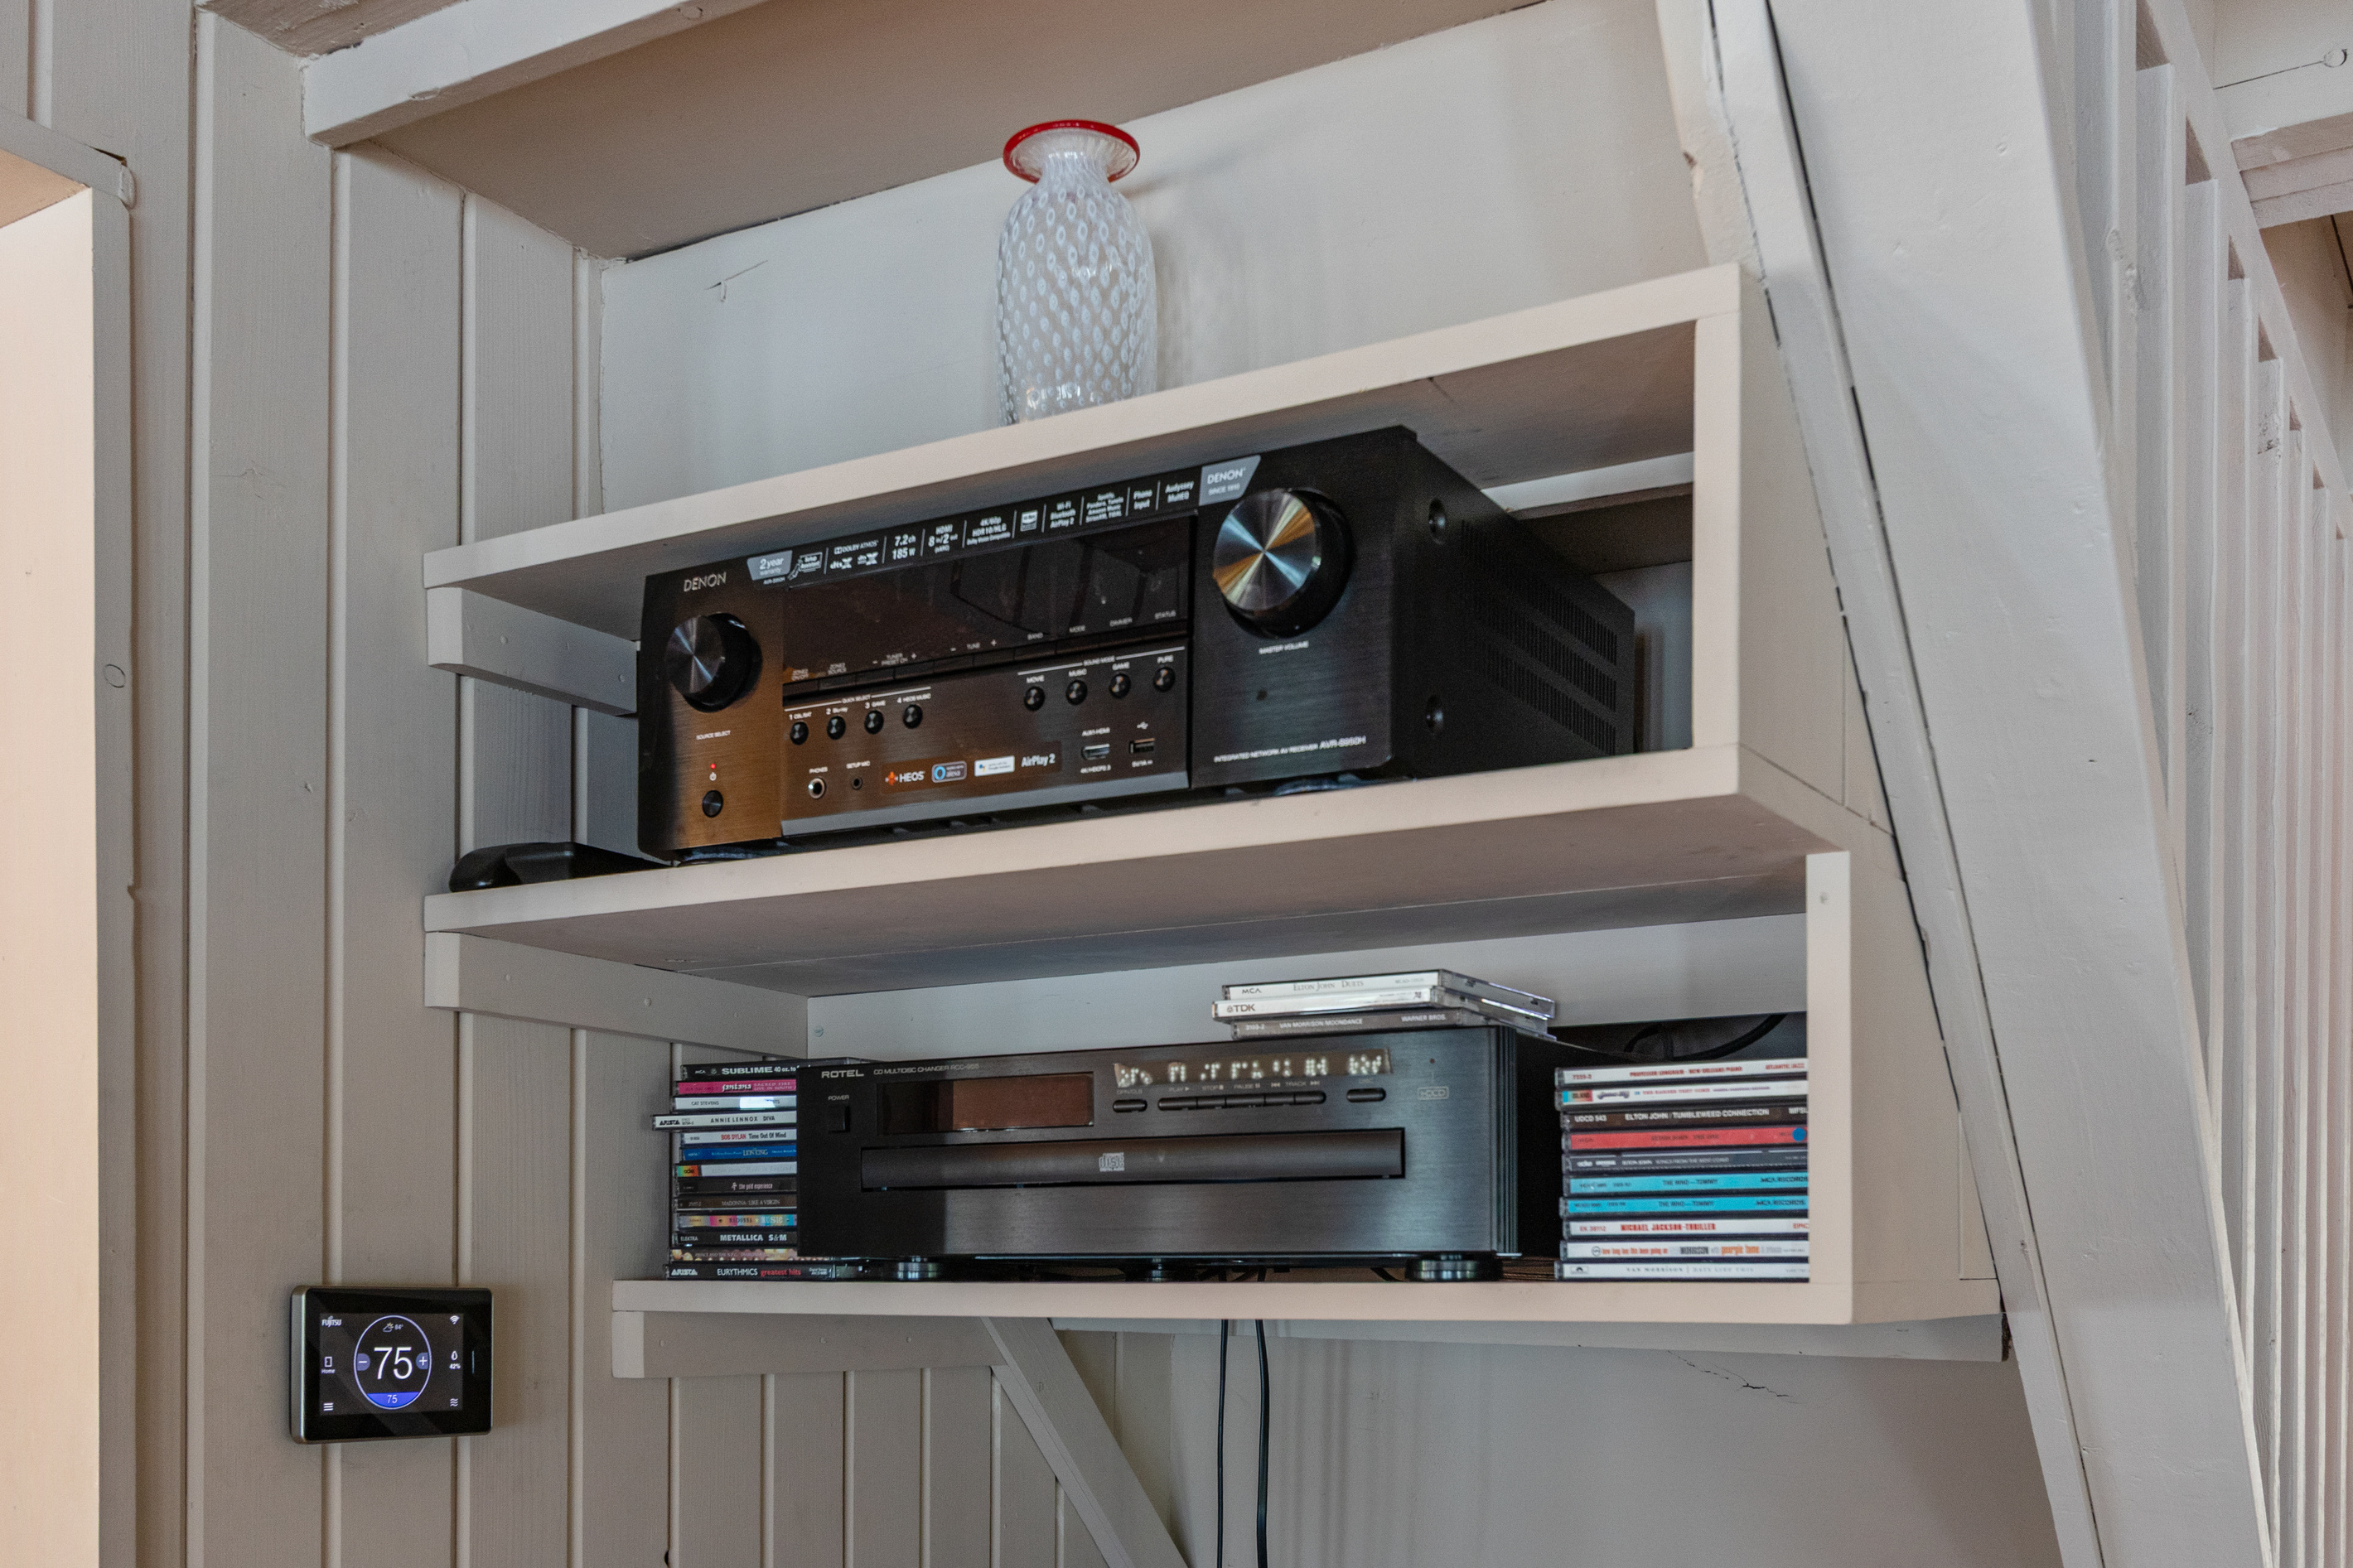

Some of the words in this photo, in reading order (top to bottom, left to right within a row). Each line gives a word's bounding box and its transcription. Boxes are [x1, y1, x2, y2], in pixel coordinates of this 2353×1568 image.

[1207, 469, 1244, 485] DENON
[1133, 490, 1152, 499] Phono
[1208, 486, 1226, 496] SINCE
[1133, 499, 1150, 510] Input
[935, 524, 953, 535] HDMI
[759, 558, 766, 570] 2
[766, 557, 784, 570] year
[684, 572, 727, 592] DENON
[1259, 644, 1284, 654] MASTER
[1284, 640, 1309, 651] VOLUME
[1112, 662, 1130, 670] GAME
[1069, 668, 1087, 677] MUSIC
[1027, 675, 1045, 683] MOVIE
[715, 730, 731, 738] SELECT
[1021, 755, 1048, 767] AirPlay
[1049, 753, 1056, 764] 2
[899, 771, 924, 784] HEOS
[1293, 983, 1315, 991] ELTON
[1316, 982, 1335, 993] JOHN
[1234, 1003, 1256, 1013] TDK
[1401, 1014, 1428, 1022] WARNER
[1292, 1020, 1324, 1029] MORRISON
[1325, 1018, 1363, 1026] MOONDANCE
[722, 1066, 773, 1075] SUBLIME
[821, 1069, 865, 1078] ROTEL
[917, 1065, 949, 1073] CHANGER
[1649, 1112, 1669, 1120] JOHN
[1722, 1108, 1770, 1117] CONNECTION
[1621, 1223, 1649, 1232] MICHAEL
[1651, 1223, 1682, 1231] JACKSON
[768, 1233, 787, 1242] S&M
[671, 1268, 698, 1276] ARISTA
[717, 1267, 758, 1276] EURYTHMICS
[761, 1269, 787, 1277] greatest
[788, 1268, 801, 1276] hits
[321, 1319, 342, 1328] FUJITSU
[374, 1346, 413, 1380] 75
[387, 1394, 398, 1404] 75
